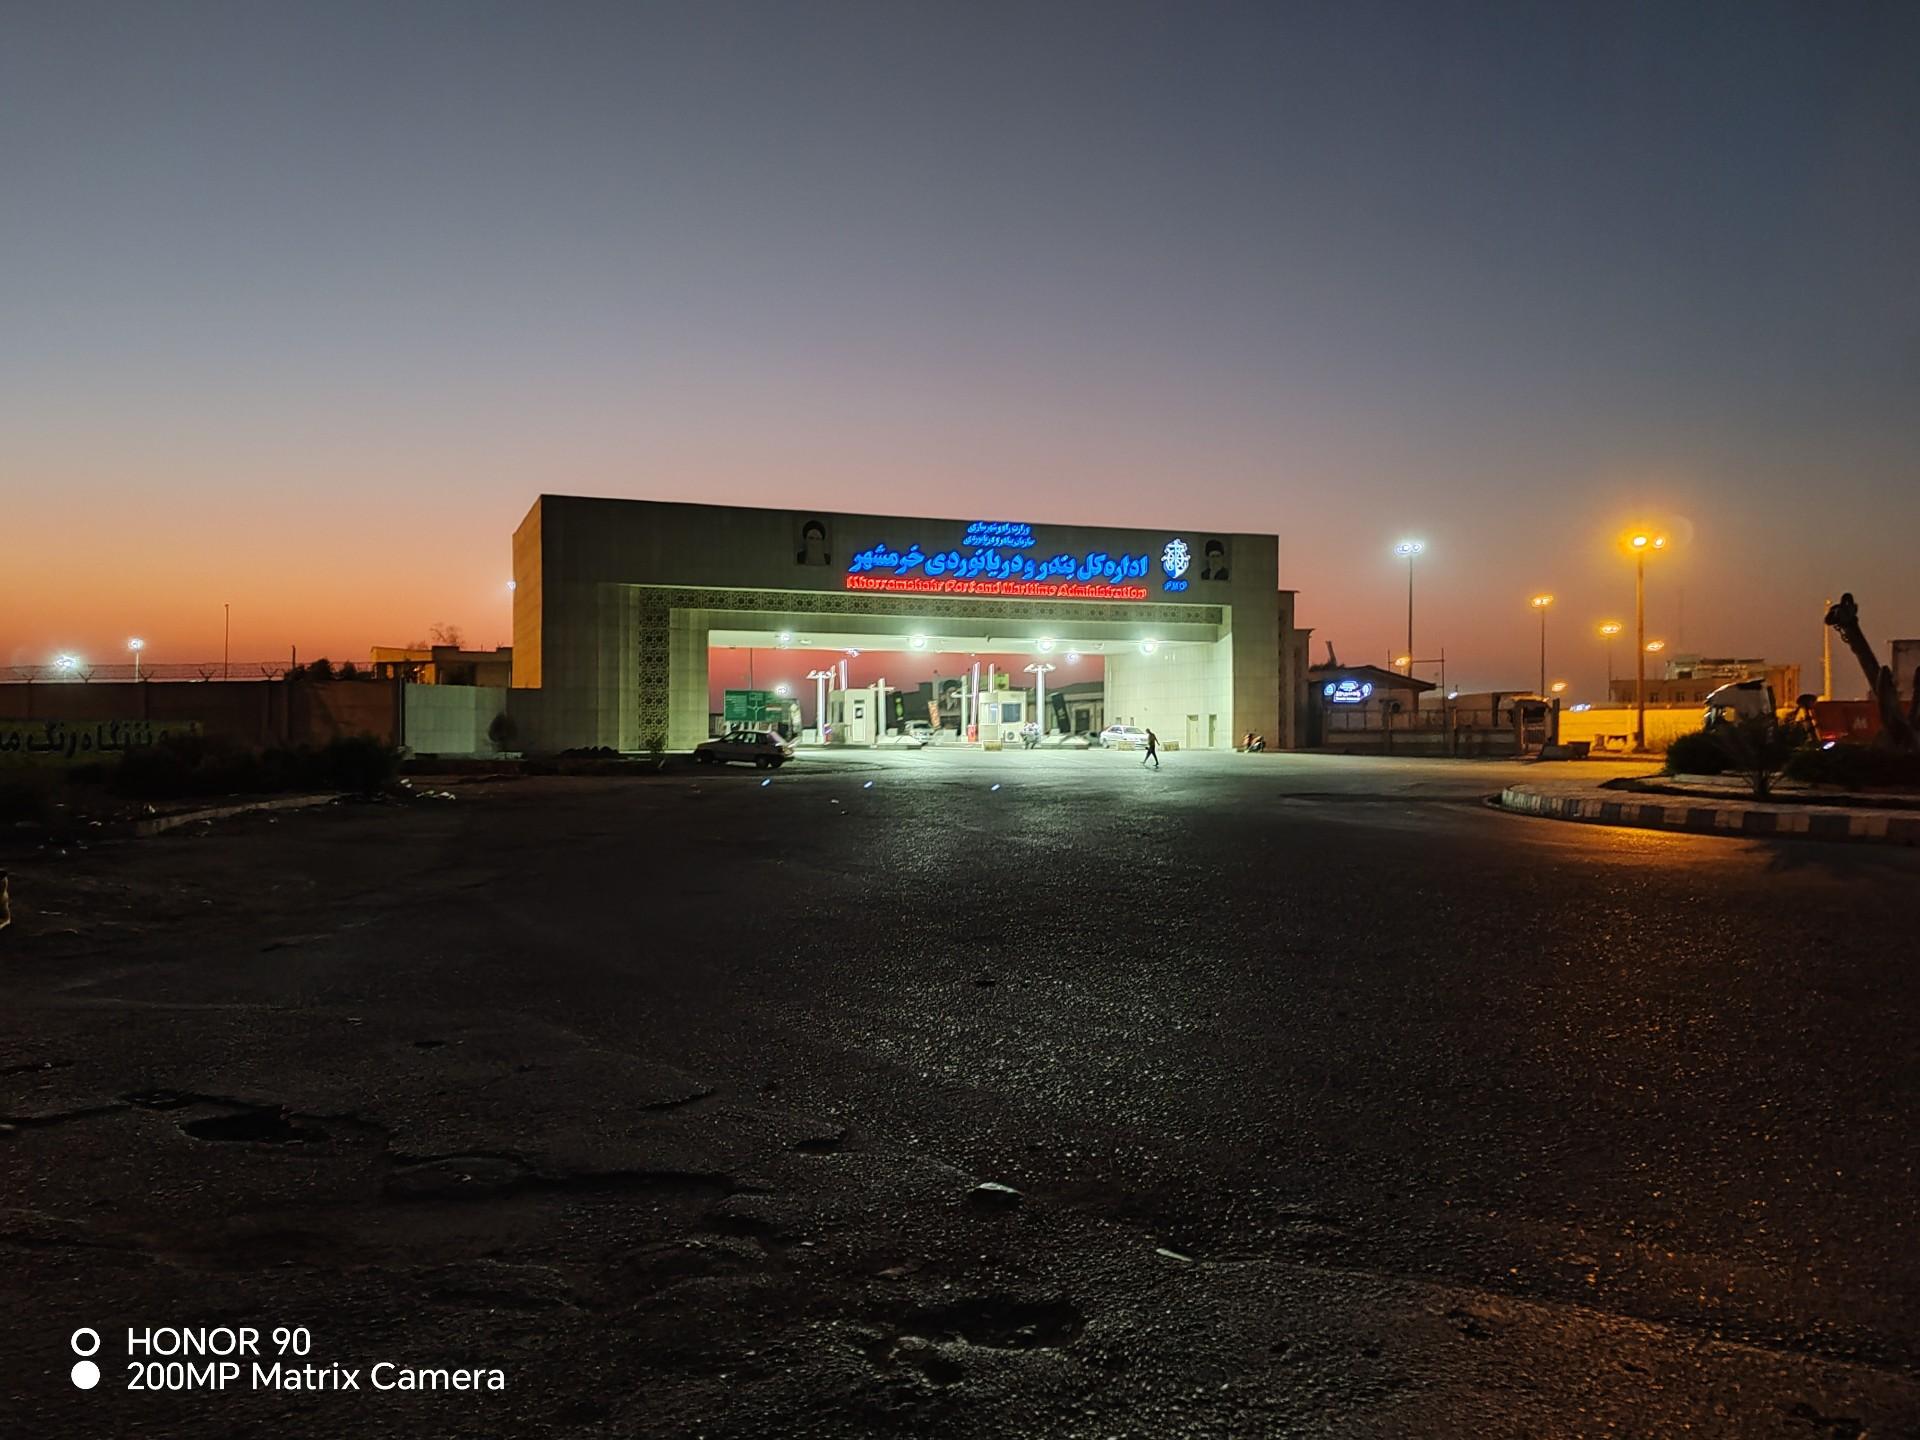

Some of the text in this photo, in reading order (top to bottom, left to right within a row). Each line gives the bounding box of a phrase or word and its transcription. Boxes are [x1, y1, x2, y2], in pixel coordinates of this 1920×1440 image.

[848, 543, 925, 575] خرمشهر
[924, 548, 1024, 578] دریانوردی
[1022, 560, 1036, 580] و
[846, 576, 1148, 599] Khorramshahr Port and Maritime Administration
[1164, 580, 1188, 592] PMO
[28, 721, 77, 758] رنگ
